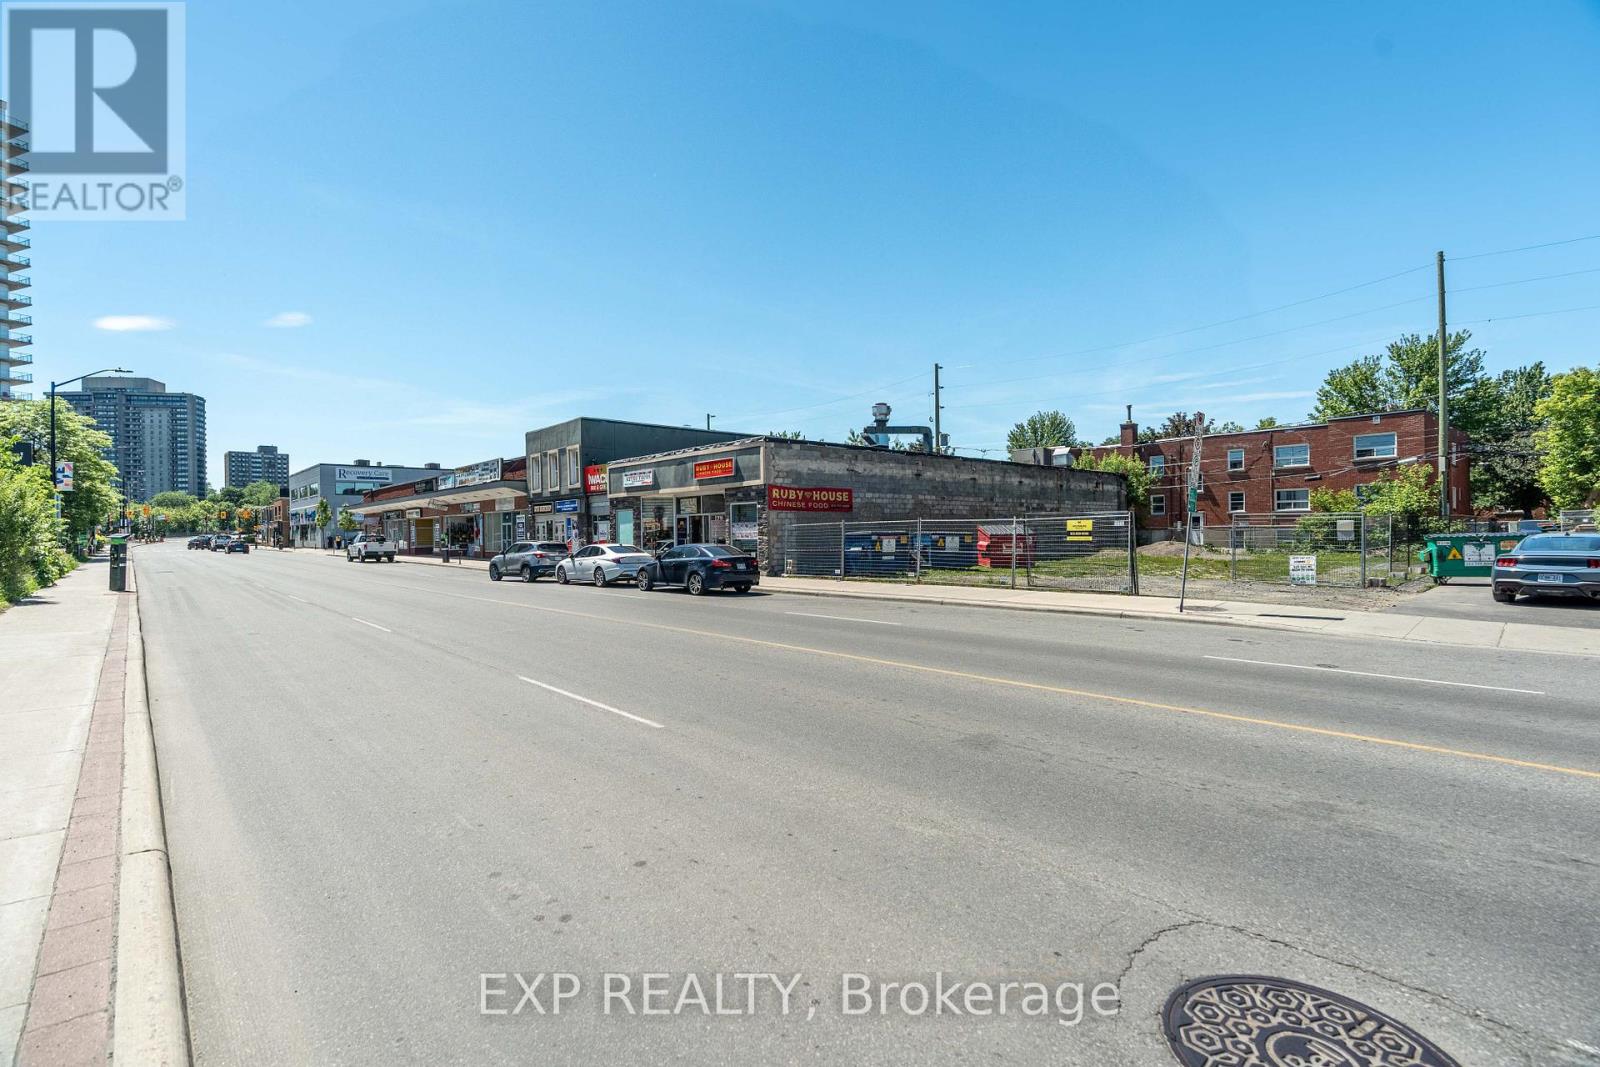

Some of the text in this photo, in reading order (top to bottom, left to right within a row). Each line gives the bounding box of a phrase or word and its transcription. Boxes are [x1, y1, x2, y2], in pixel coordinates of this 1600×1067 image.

[713, 461, 732, 469] HOUSE
[338, 468, 373, 479] Recovery
[772, 488, 849, 501] RUBY HOUSE
[772, 500, 806, 508] CHINESE
